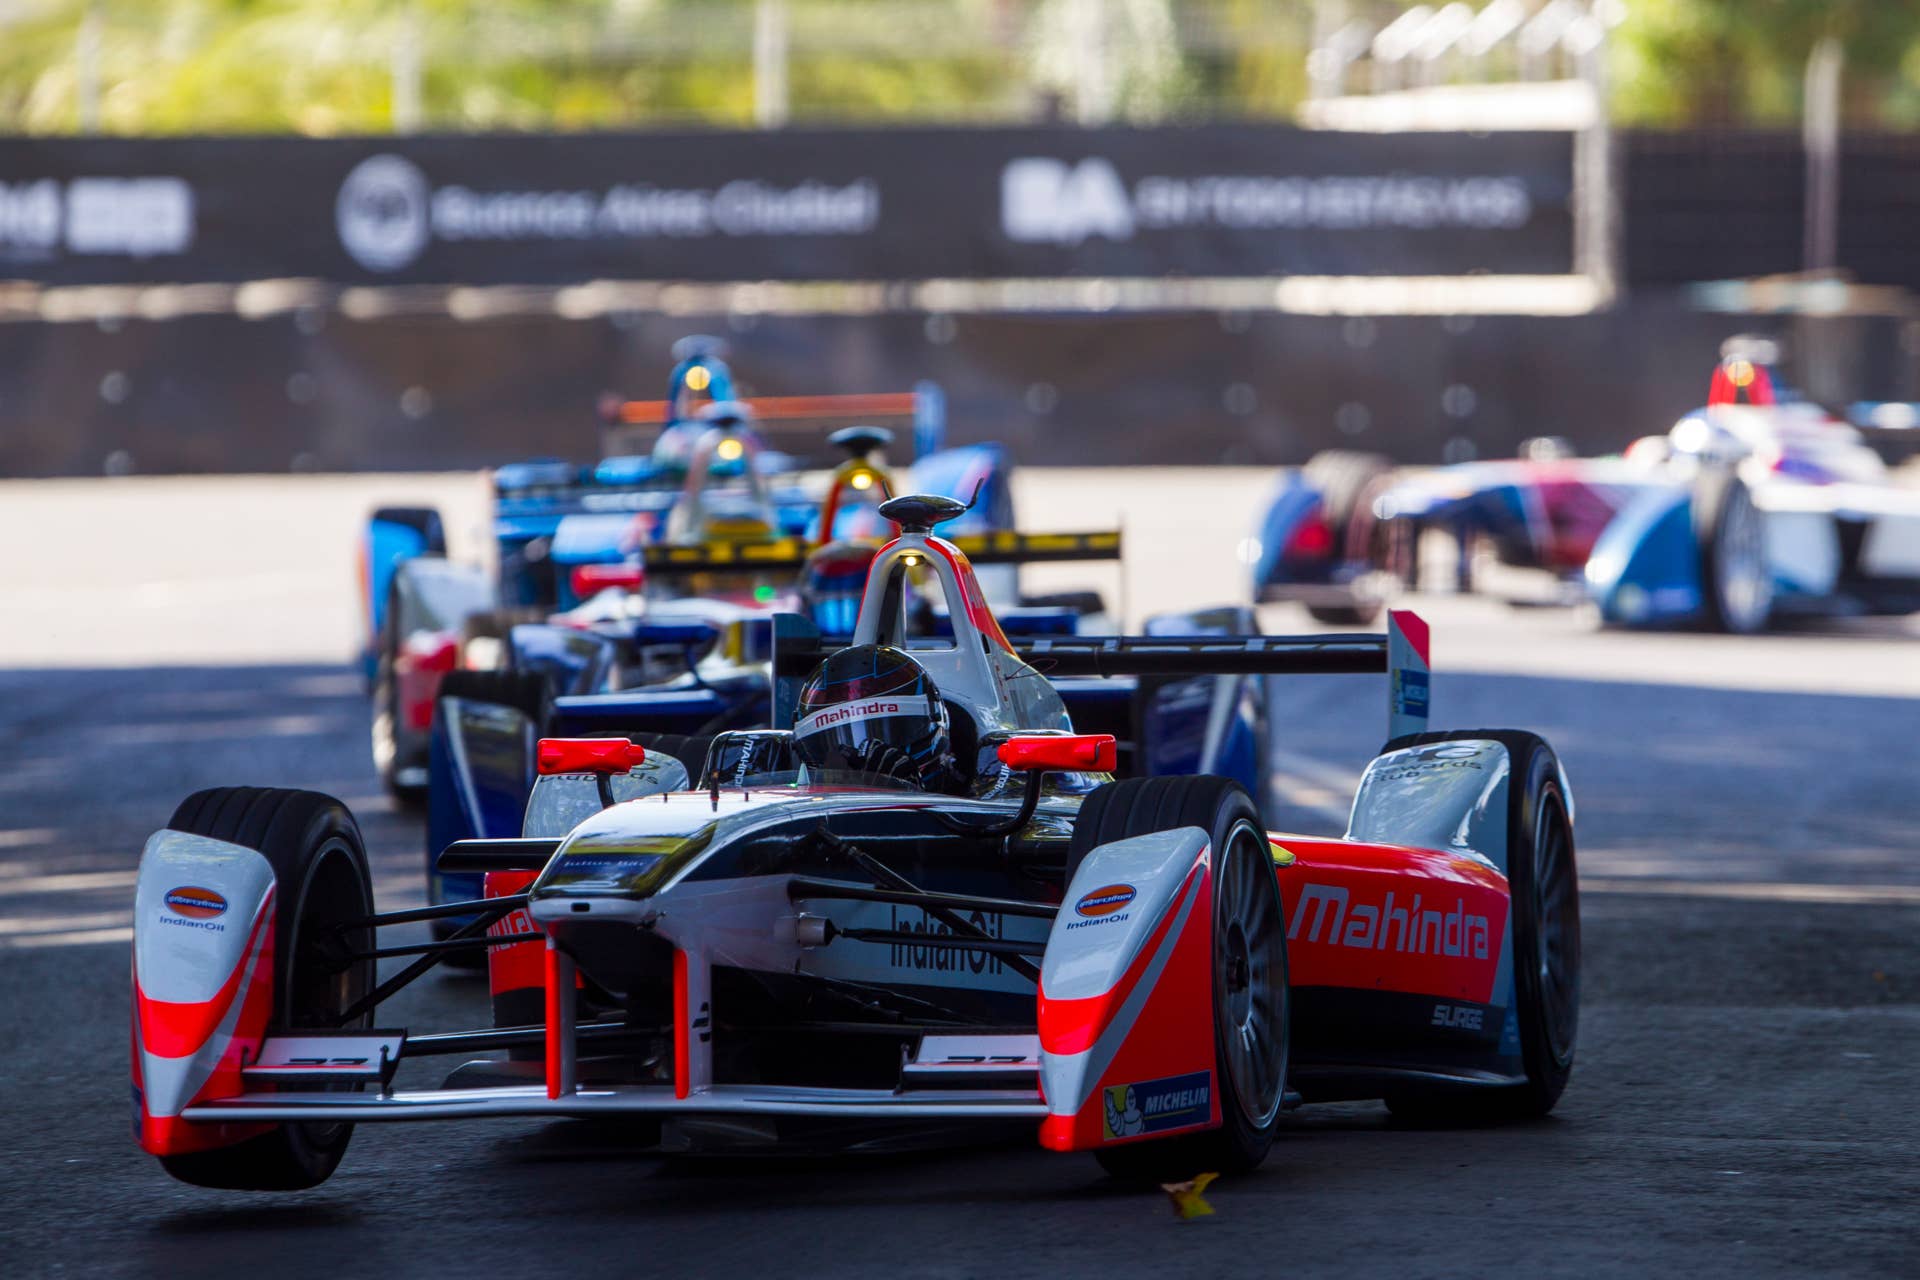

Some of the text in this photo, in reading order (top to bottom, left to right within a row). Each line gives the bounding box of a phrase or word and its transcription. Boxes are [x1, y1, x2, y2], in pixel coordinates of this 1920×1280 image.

[815, 702, 899, 729] Mahindra
[160, 915, 225, 932] IndianOil
[1066, 913, 1129, 930] IndianOil
[1287, 883, 1489, 960] Mahindra
[1145, 1086, 1209, 1114] MICHELIN
